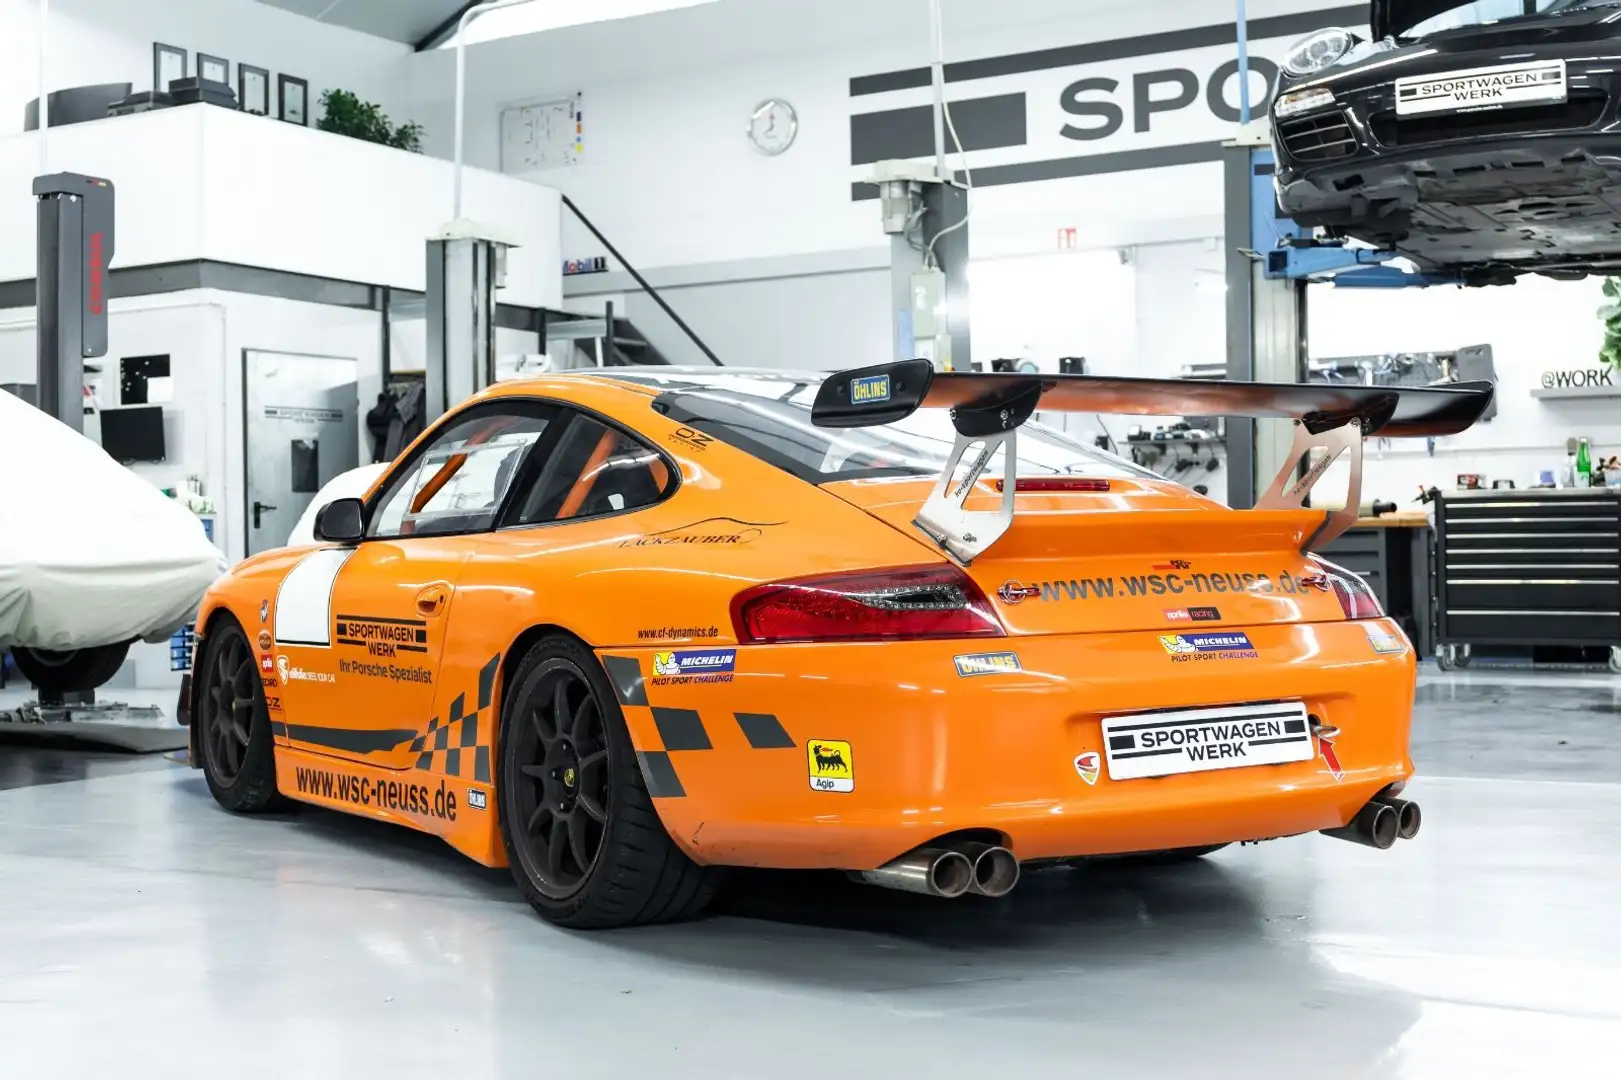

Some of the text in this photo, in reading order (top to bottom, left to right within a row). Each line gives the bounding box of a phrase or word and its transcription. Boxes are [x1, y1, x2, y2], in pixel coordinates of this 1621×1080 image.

[1422, 73, 1537, 95] SPORTWAGEN
[1454, 88, 1502, 101] WERK
[1541, 364, 1613, 389] @WORK
[853, 380, 888, 400] ÖHLINS
[348, 623, 414, 642] SPORTWAGEN
[638, 625, 719, 640] www.cf-dynamics.de
[1193, 636, 1248, 647] MICHELIN
[367, 641, 396, 658] WERK
[1194, 653, 1216, 661] SPORT
[1218, 651, 1259, 659] CHALLENGE
[681, 655, 734, 667] MICHELIN
[339, 658, 432, 684] Ihr Porsche Spezialist
[651, 674, 734, 687] PILOT SPORT CHALLENGE
[1141, 721, 1280, 748] SPORTWAGEN
[1186, 742, 1246, 761] WERK
[816, 778, 835, 789] Agip
[296, 767, 456, 821] www.wsc-neuss.de
